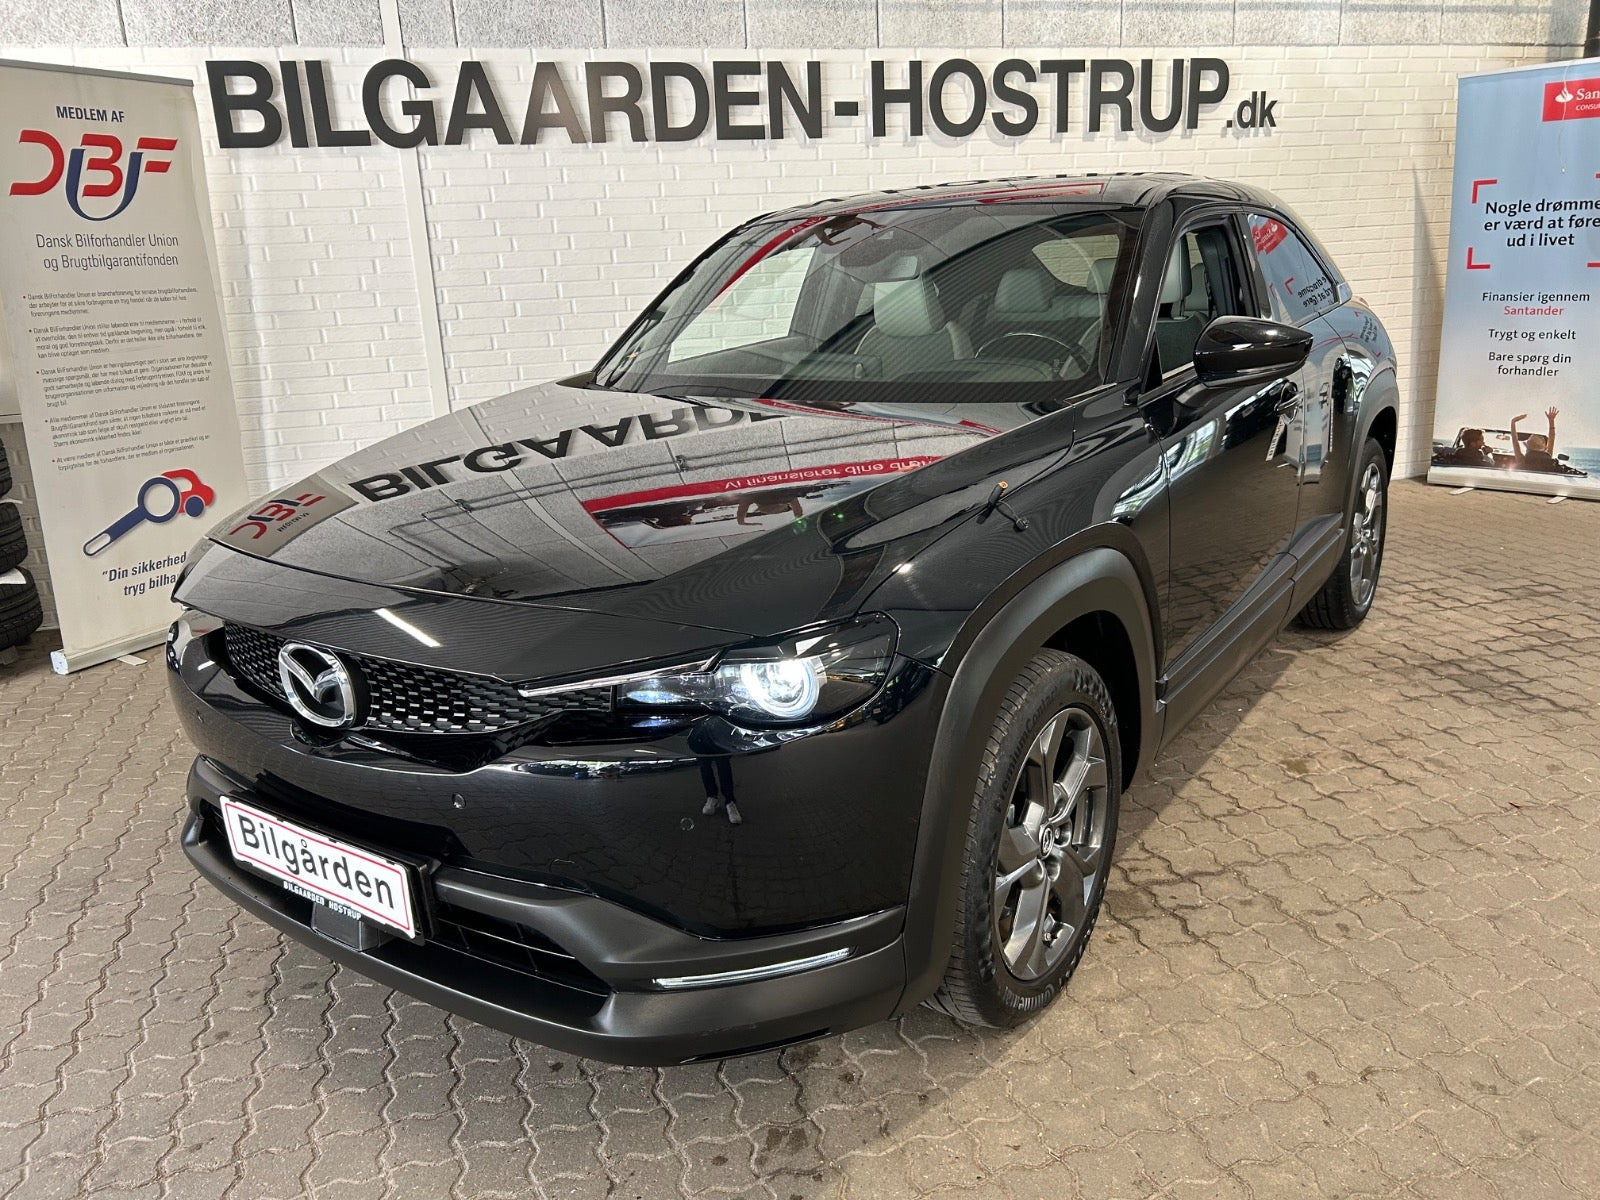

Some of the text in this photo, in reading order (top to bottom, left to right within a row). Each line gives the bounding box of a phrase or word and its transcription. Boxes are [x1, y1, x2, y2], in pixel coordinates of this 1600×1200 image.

[56, 105, 125, 123] MEDLEM AF
[1485, 198, 1600, 217] Nogle drømme
[1484, 214, 1600, 231] er værd at føre
[36, 232, 179, 248] Dansk Bilforhandler Union
[1506, 233, 1575, 247] ud i livet
[43, 253, 179, 272] og Brugtbilgarantifonden
[1482, 291, 1590, 304] Finansier igennem
[1503, 305, 1565, 316] Santander
[1488, 328, 1577, 341] Trygt og enkelt
[1488, 351, 1572, 365] Bare spørg din
[1497, 365, 1559, 377] forhandler
[131, 551, 187, 576] sikkerhed
[124, 573, 178, 597] tryg bilha
[237, 814, 394, 909] Bilgården
[283, 880, 362, 921] BILGAARDEN HOSTRUP
